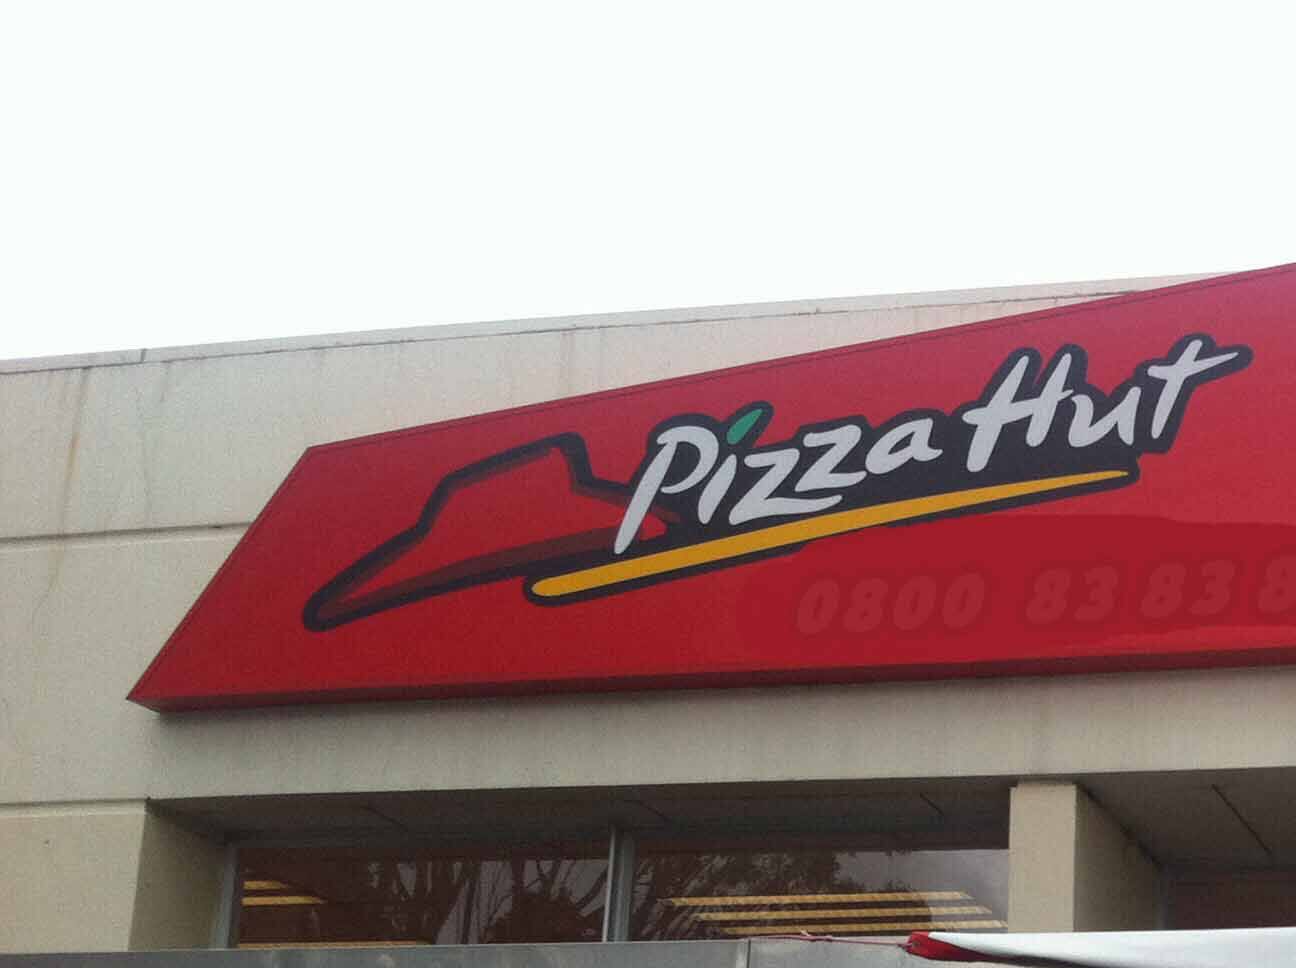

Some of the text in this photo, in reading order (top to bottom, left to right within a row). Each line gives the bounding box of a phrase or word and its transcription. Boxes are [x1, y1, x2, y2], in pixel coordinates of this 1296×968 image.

[614, 338, 1239, 555] Pizza Hut
[796, 571, 985, 635] 0800
[1024, 564, 1119, 625] 83
[1140, 558, 1235, 622] 83
